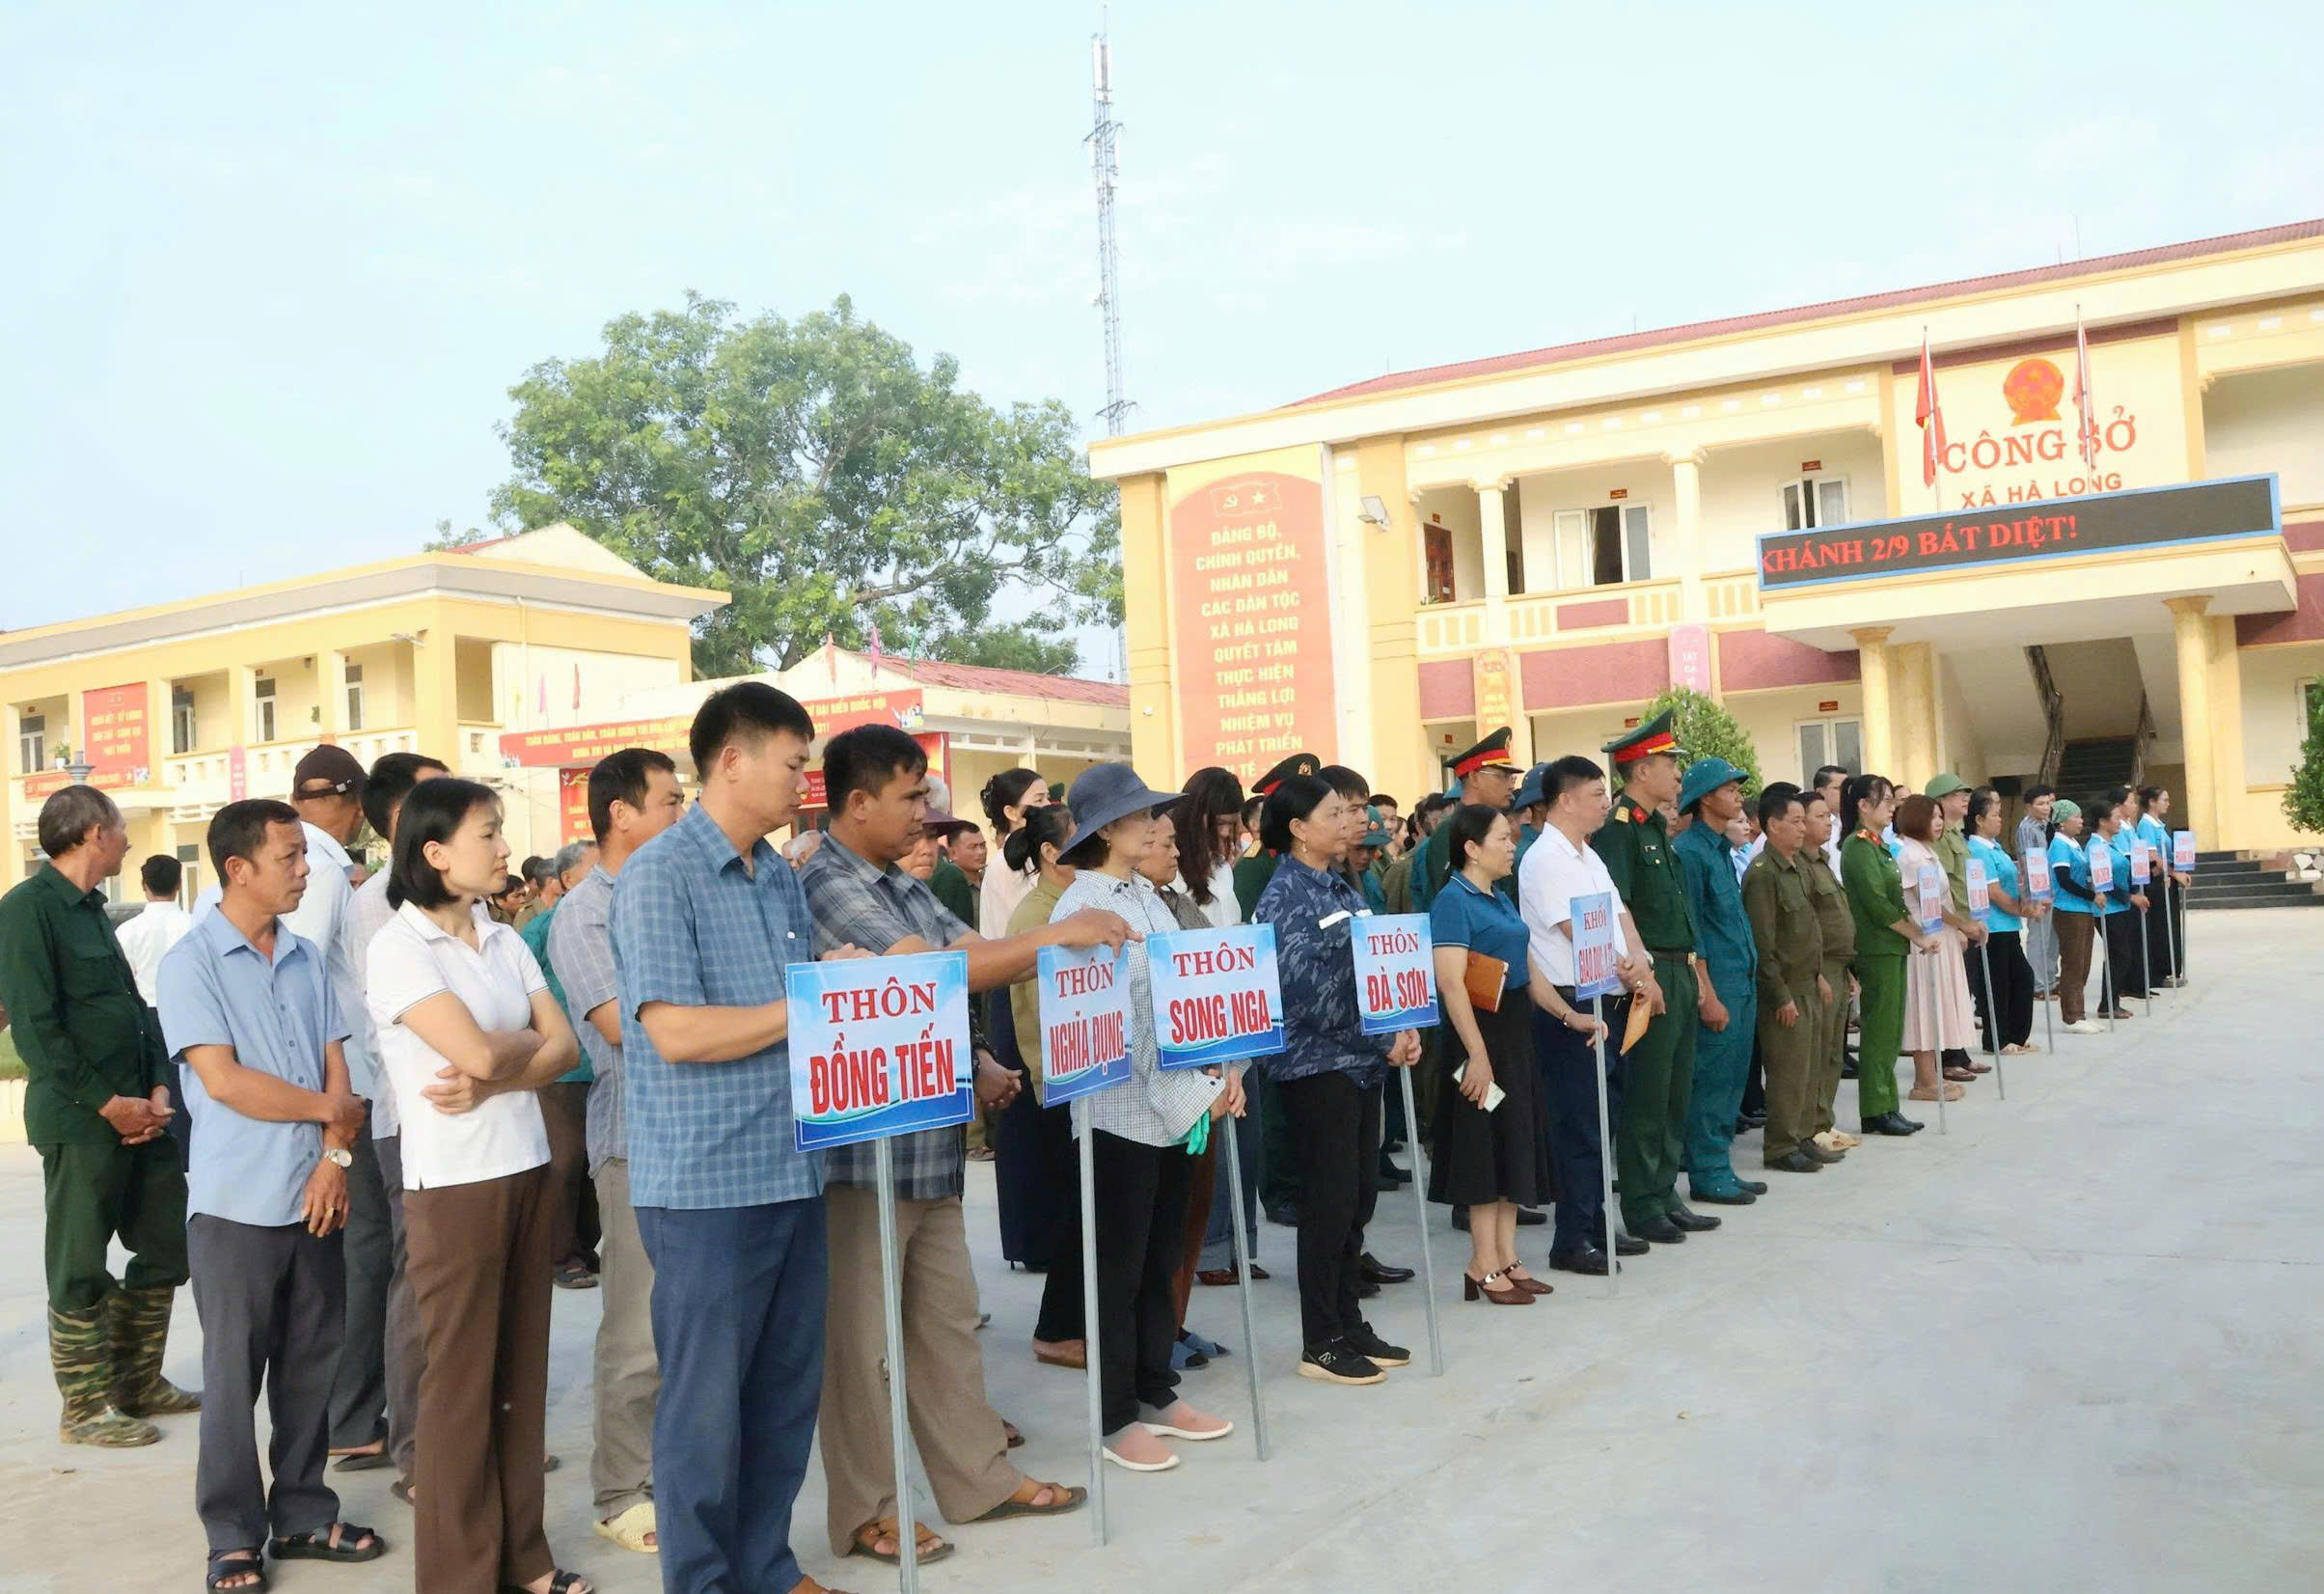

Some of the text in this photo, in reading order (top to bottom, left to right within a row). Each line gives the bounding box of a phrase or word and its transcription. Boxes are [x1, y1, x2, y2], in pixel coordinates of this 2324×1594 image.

[1944, 429, 2066, 473] CÔNG
[1961, 473, 2122, 508] XÃ HÀ LONG
[1872, 535, 1910, 561] 2/9
[1988, 515, 2077, 550] DIỆT!
[1195, 551, 1242, 571] CHÍNH
[1258, 616, 1299, 633] LONG
[1583, 903, 1607, 930] KHỐI
[1173, 942, 1254, 976] THÔN
[1368, 927, 1419, 955] THÔN
[1055, 957, 1114, 998] THÔN
[1367, 966, 1429, 1011] ĐÀ SƠN
[822, 976, 936, 1024] THÔN
[1169, 989, 1271, 1043] SONG NGA
[1050, 1010, 1090, 1076] NGHĨA
[809, 1023, 955, 1114] ĐỒNG TIẾN
